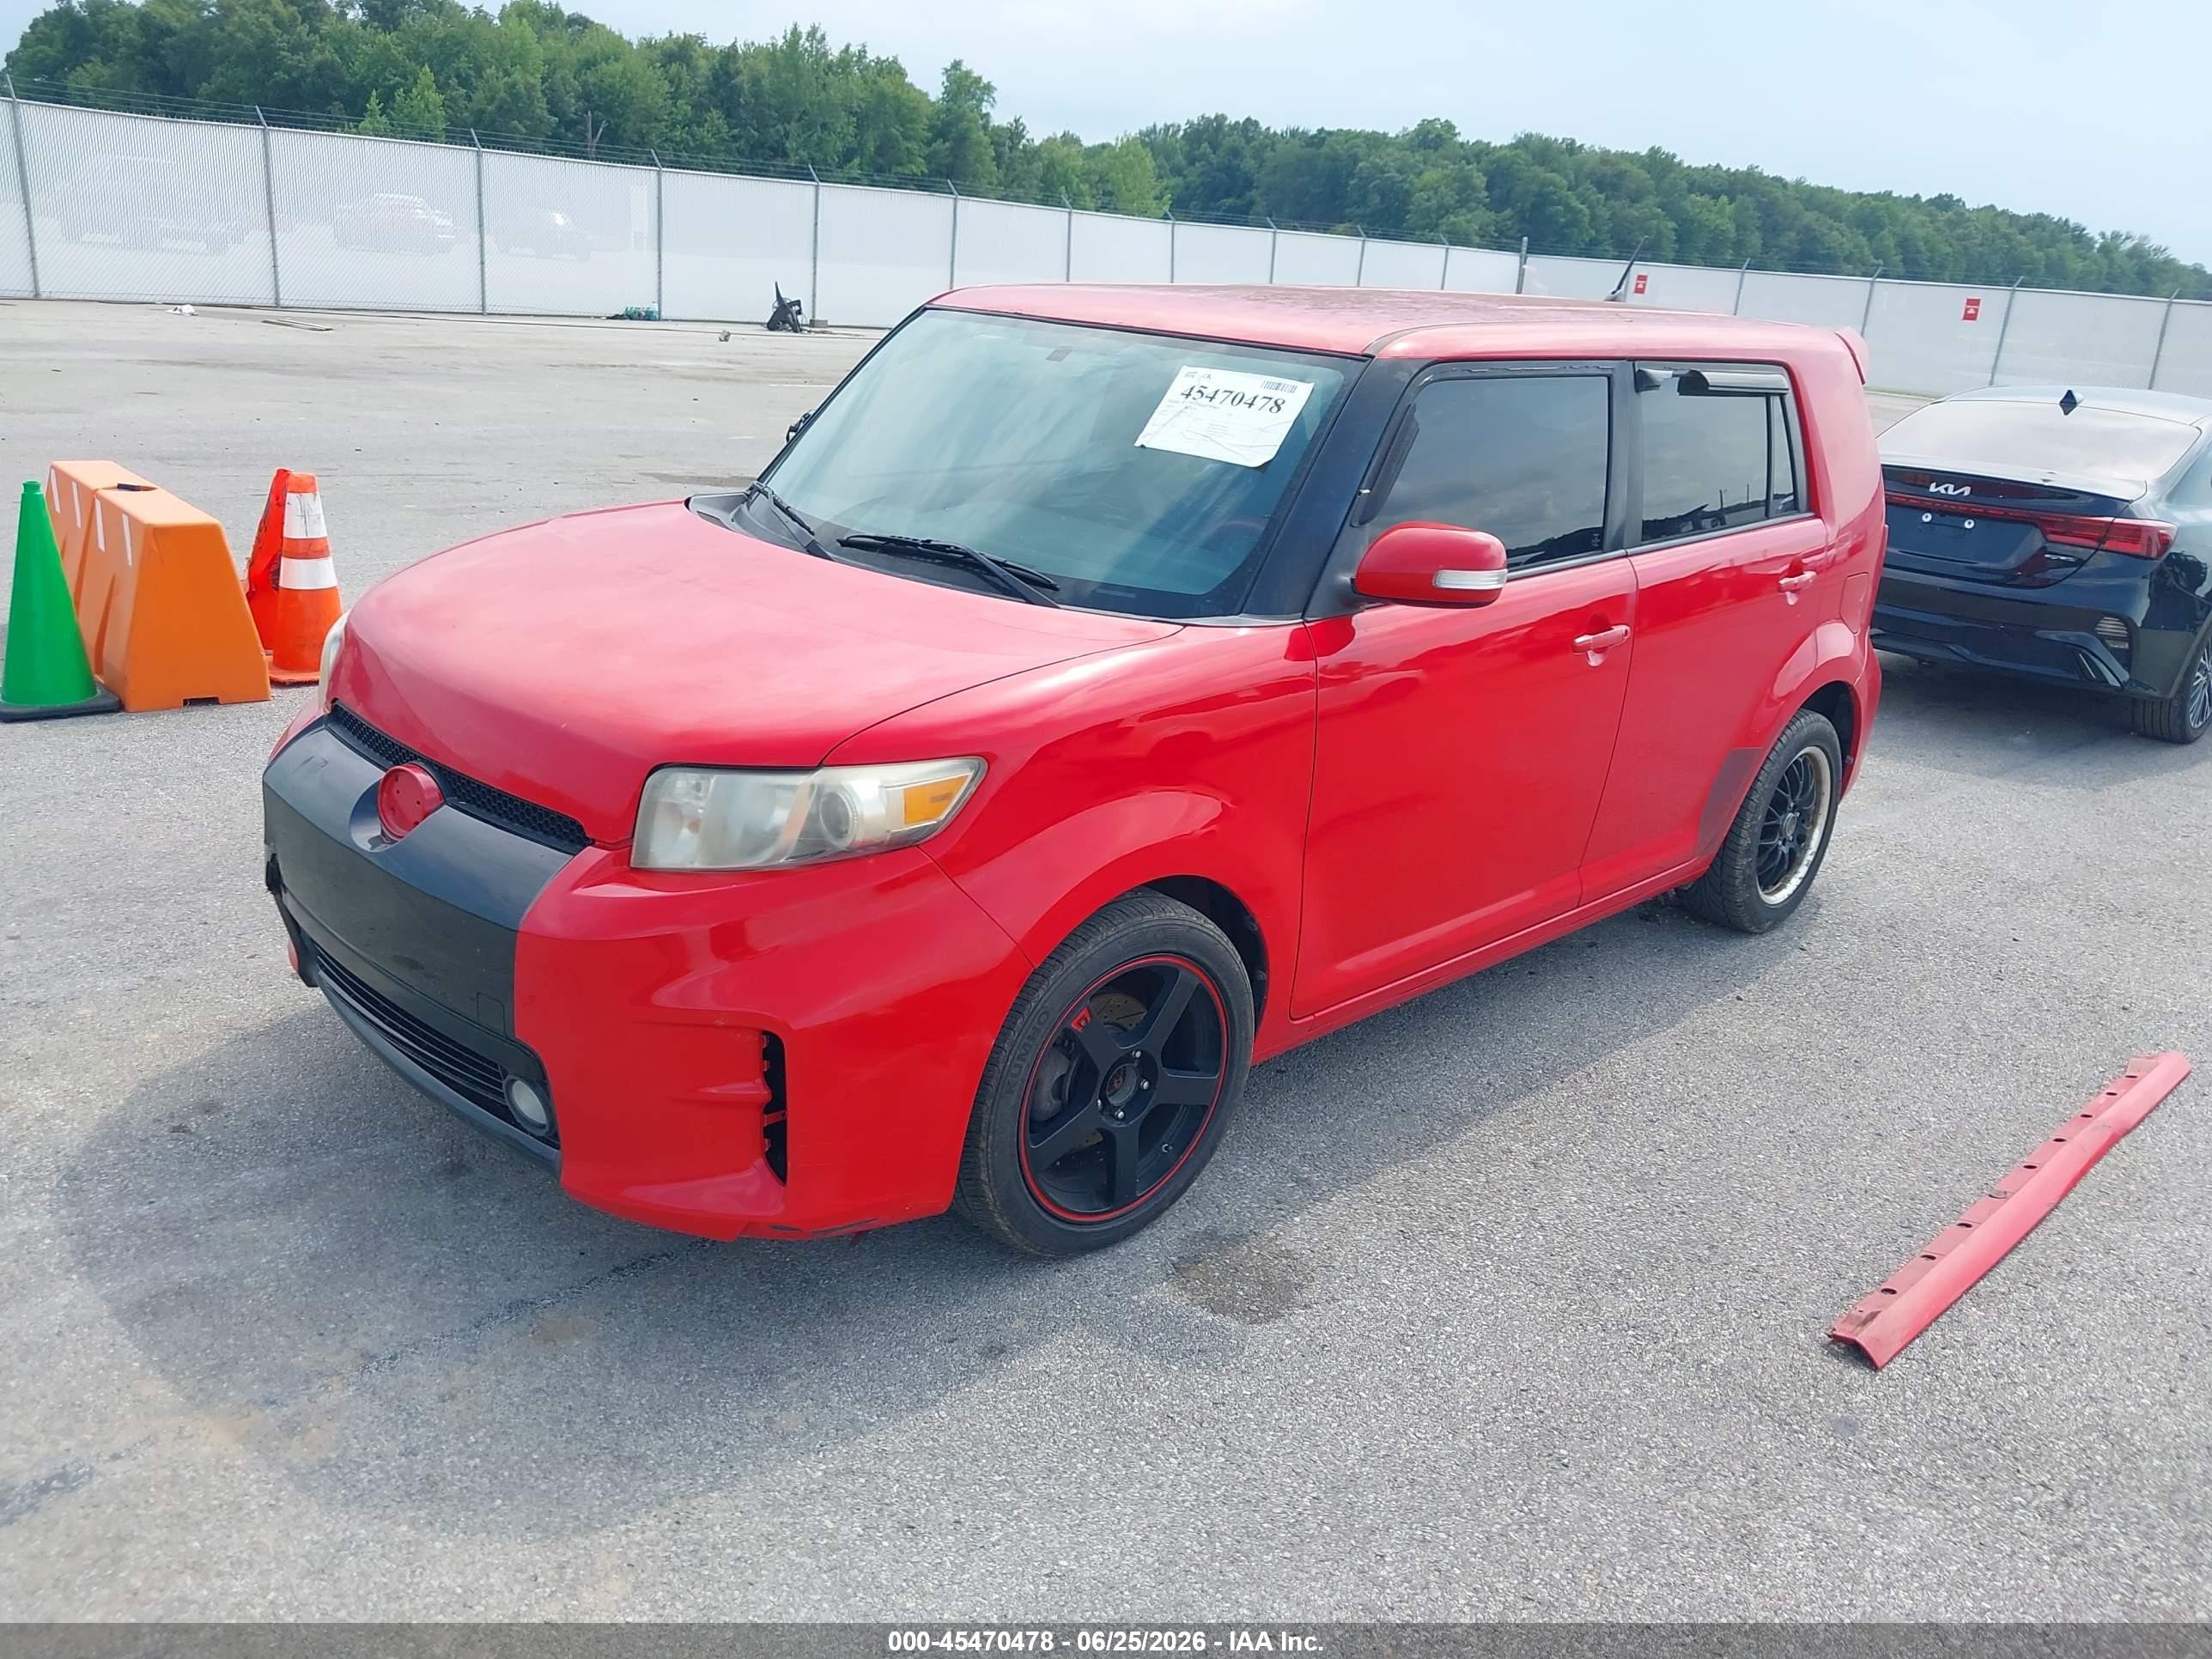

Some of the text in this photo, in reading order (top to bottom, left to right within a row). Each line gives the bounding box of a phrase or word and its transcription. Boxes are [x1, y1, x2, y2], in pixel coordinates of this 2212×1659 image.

[1180, 384, 1286, 414] 45470478
[1929, 481, 1972, 496] KIA
[1001, 1009, 1050, 1097] KUMHO
